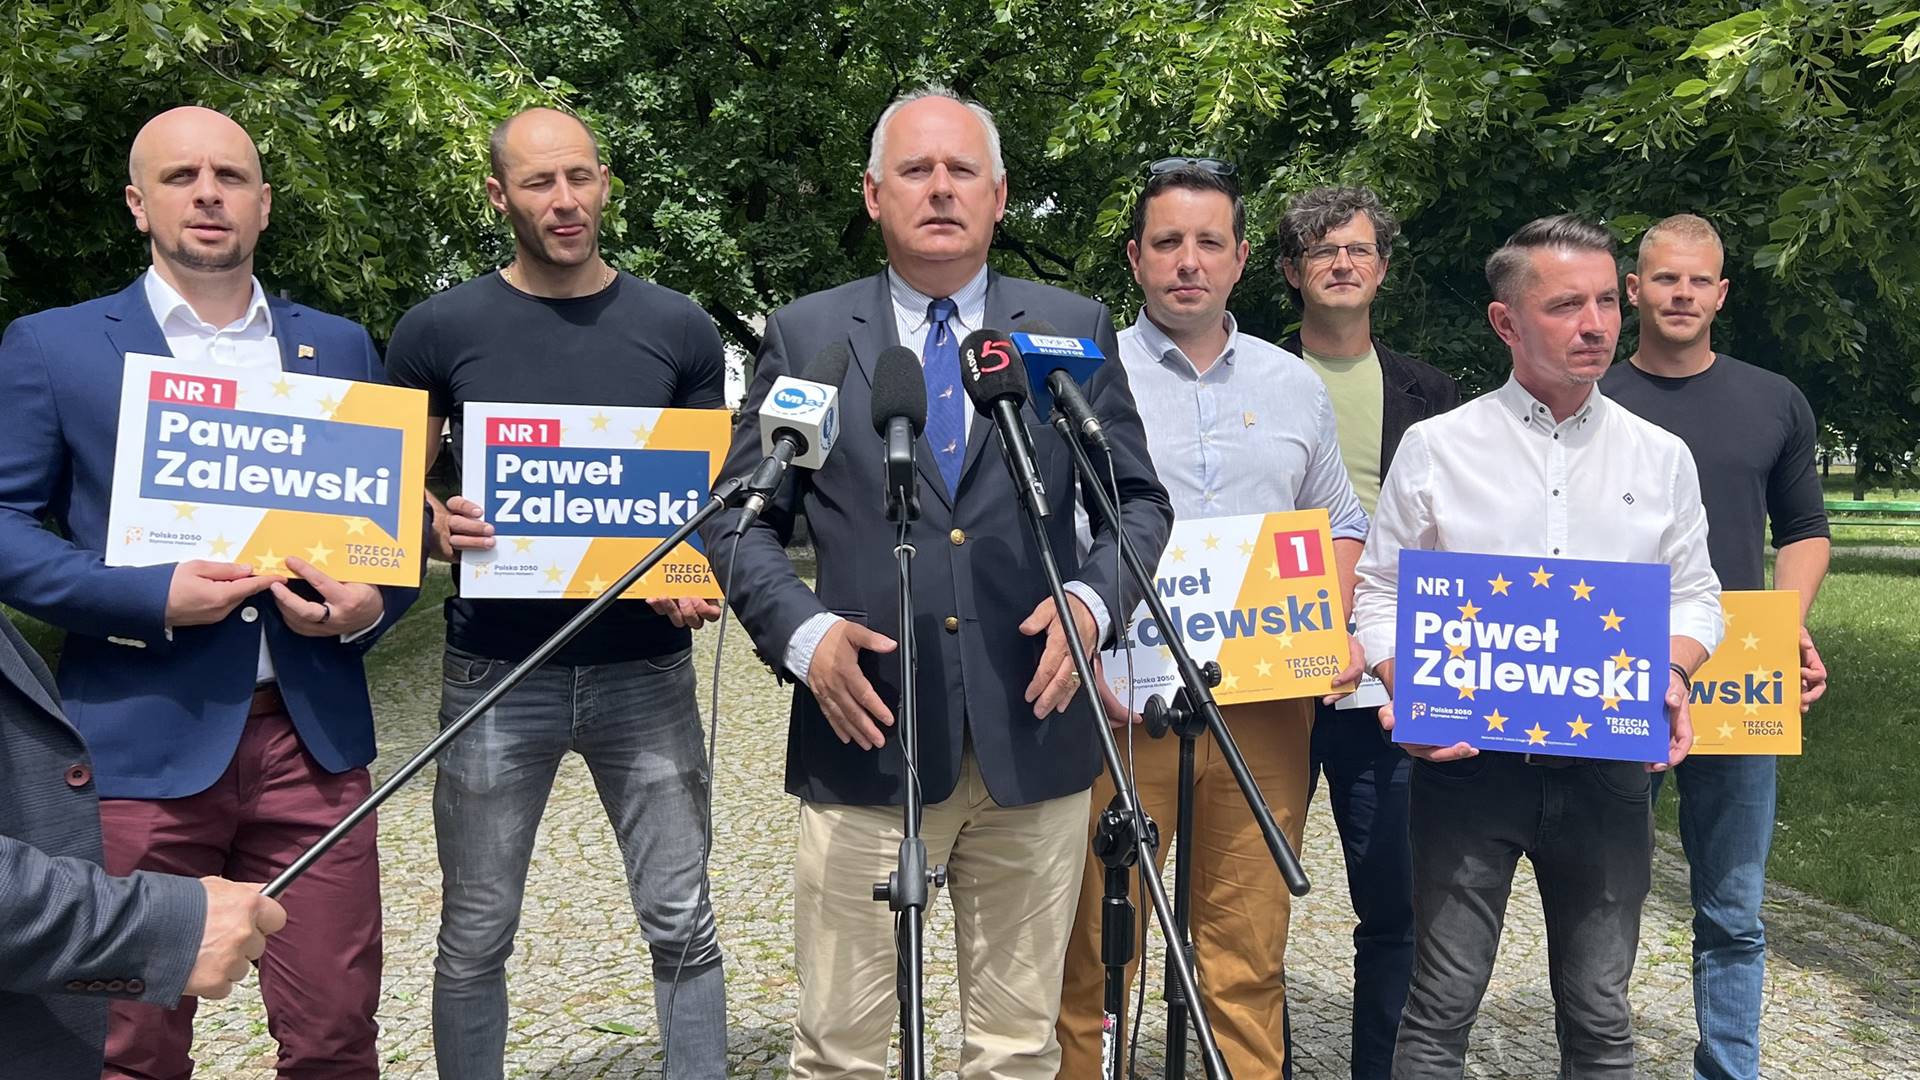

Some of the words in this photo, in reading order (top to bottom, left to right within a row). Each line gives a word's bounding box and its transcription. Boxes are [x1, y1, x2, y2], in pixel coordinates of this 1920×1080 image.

[981, 340, 1012, 373] 5
[164, 379, 204, 401] NR
[212, 384, 222, 403] 1
[159, 411, 306, 455] Paweł
[498, 424, 532, 442] NR
[538, 425, 548, 442] 1
[154, 449, 390, 505] Zalewski
[496, 453, 623, 486] Paweł
[495, 489, 699, 525] Zalewski
[149, 531, 178, 540] Polska
[179, 533, 202, 541] 2050
[345, 543, 406, 559] TRZECIA
[348, 554, 401, 569] DROGA
[1290, 536, 1309, 572] 1
[662, 564, 713, 573] TRZECIA
[665, 574, 711, 583] DROGA
[1157, 568, 1211, 598] weł
[1416, 577, 1449, 596] NR
[1455, 579, 1464, 597] 1
[1113, 589, 1333, 650] alewski
[1415, 611, 1559, 653] Paweł
[1285, 656, 1340, 668] TRZECIA
[1295, 666, 1341, 679] DROGA
[1413, 649, 1650, 702] Zalewski
[1689, 671, 1783, 704] wski
[1430, 706, 1452, 714] Polska
[1605, 717, 1650, 728] TRZECIA
[1611, 726, 1650, 737] DROGA
